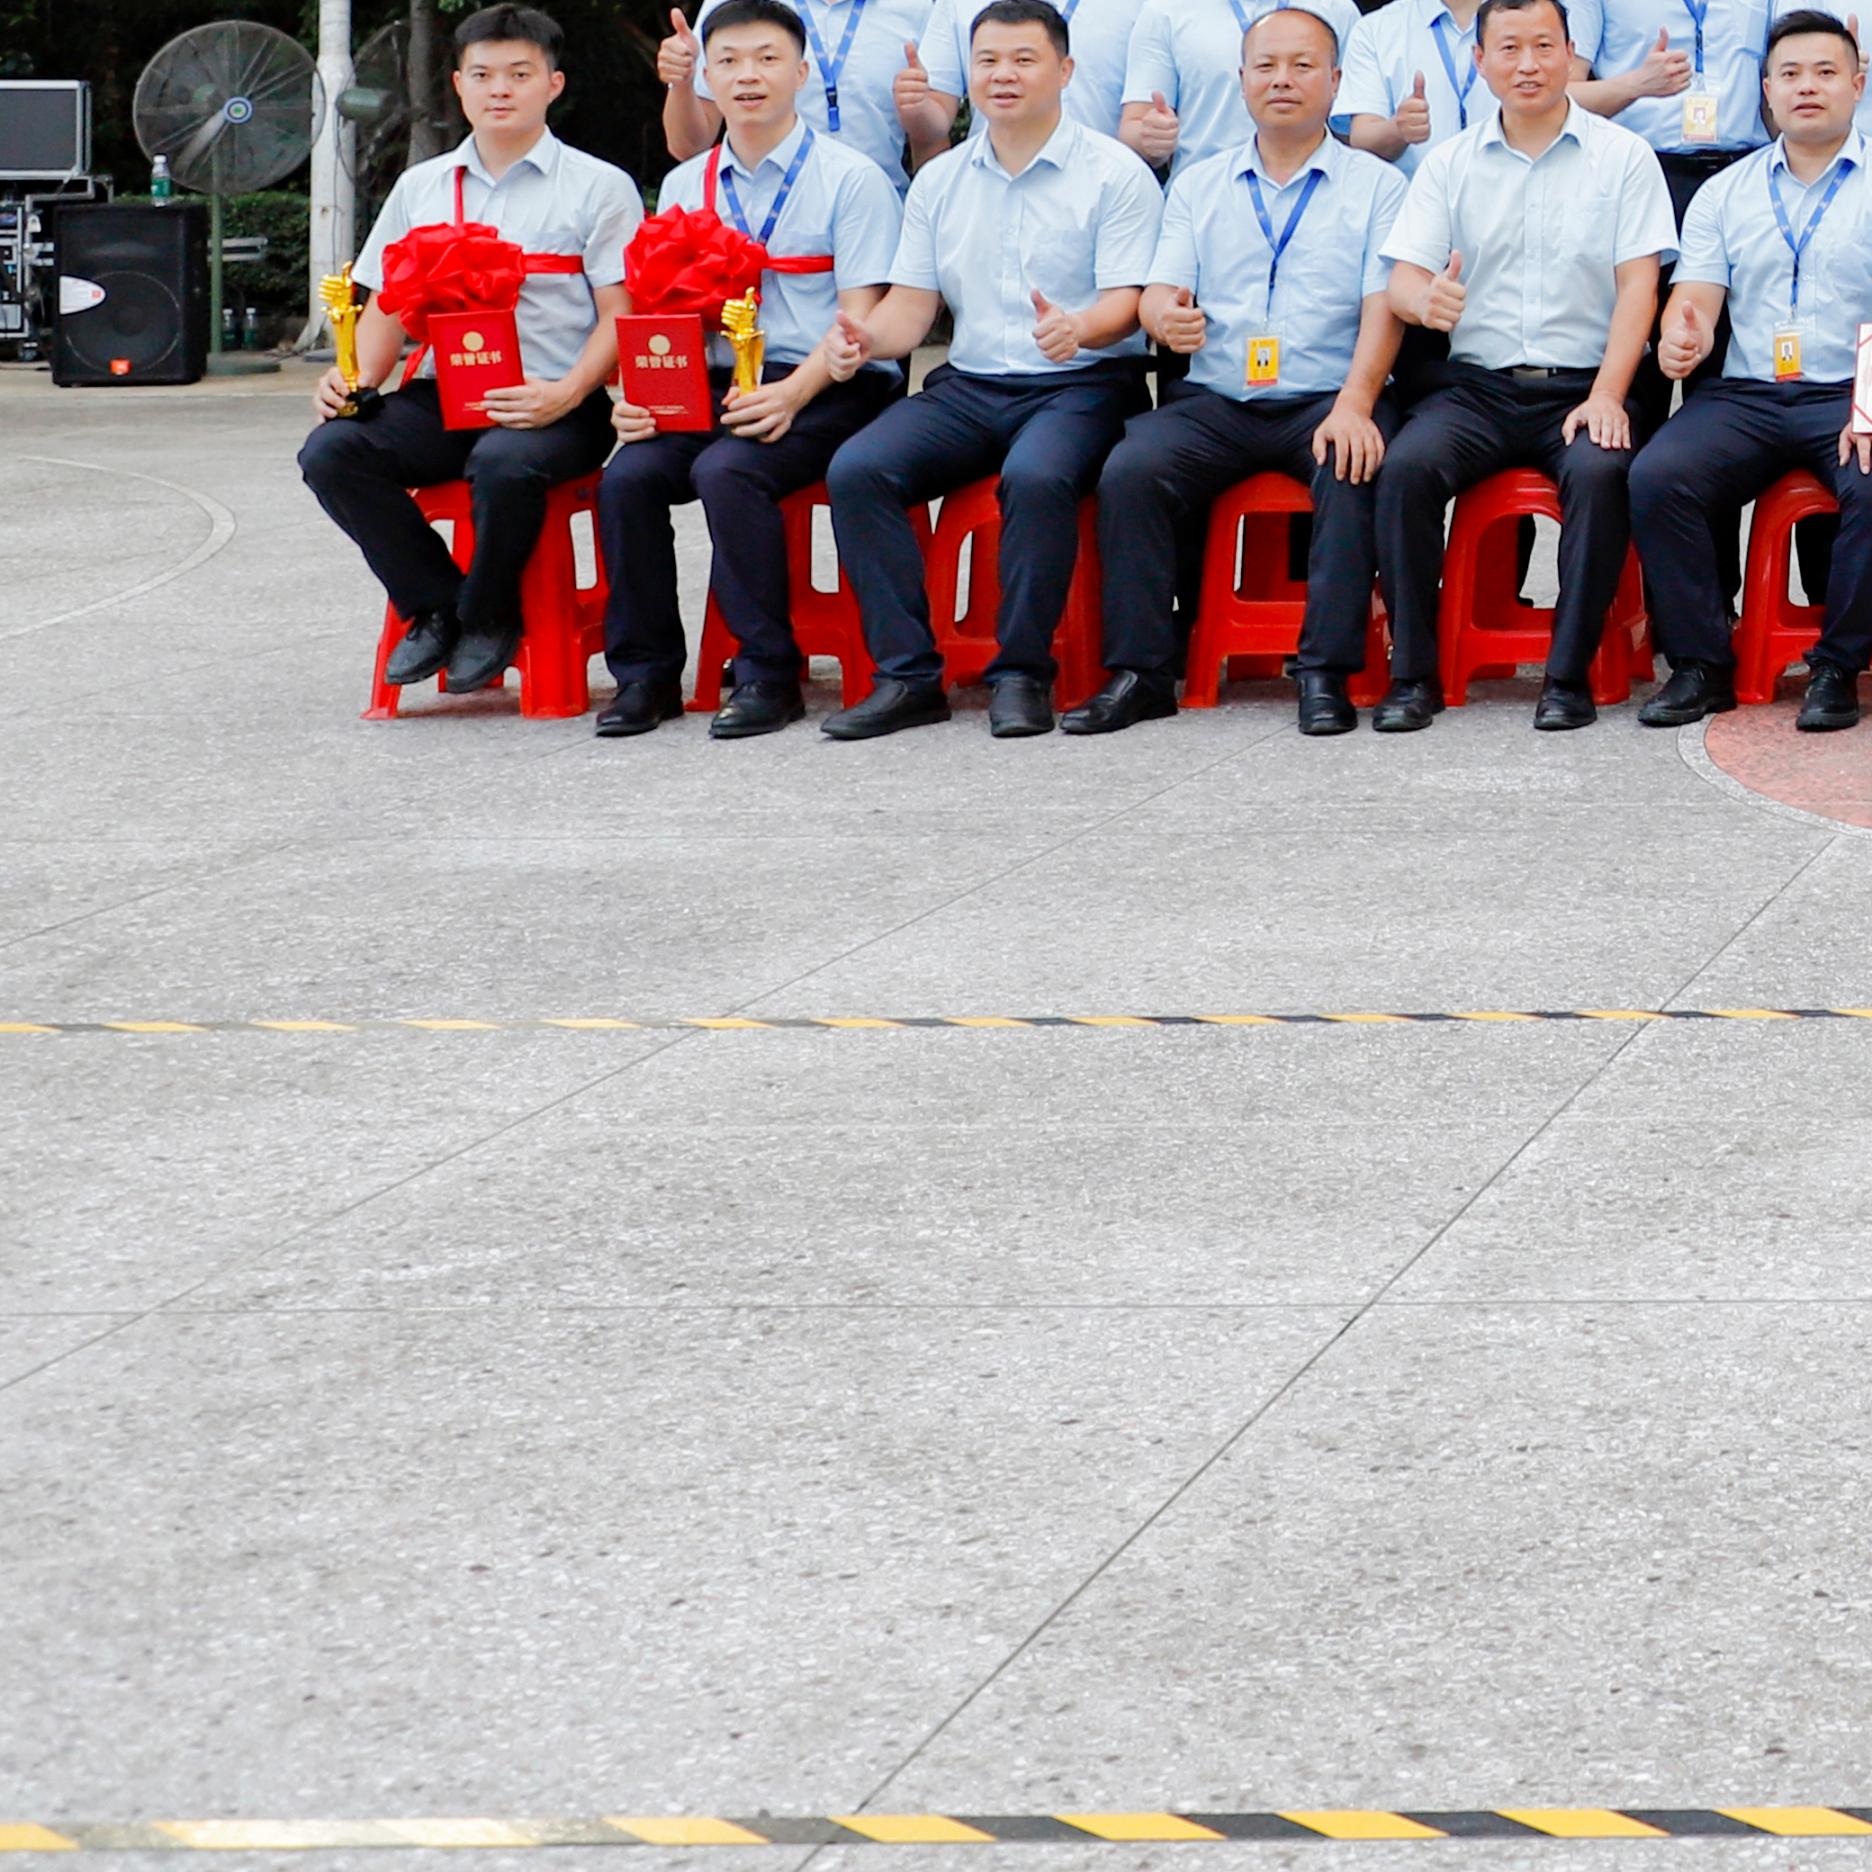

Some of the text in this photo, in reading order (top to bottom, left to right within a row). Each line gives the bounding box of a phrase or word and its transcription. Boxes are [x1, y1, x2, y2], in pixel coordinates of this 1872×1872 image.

[449, 349, 502, 367] 荣誉证书
[634, 354, 688, 369] 荣誉证书
